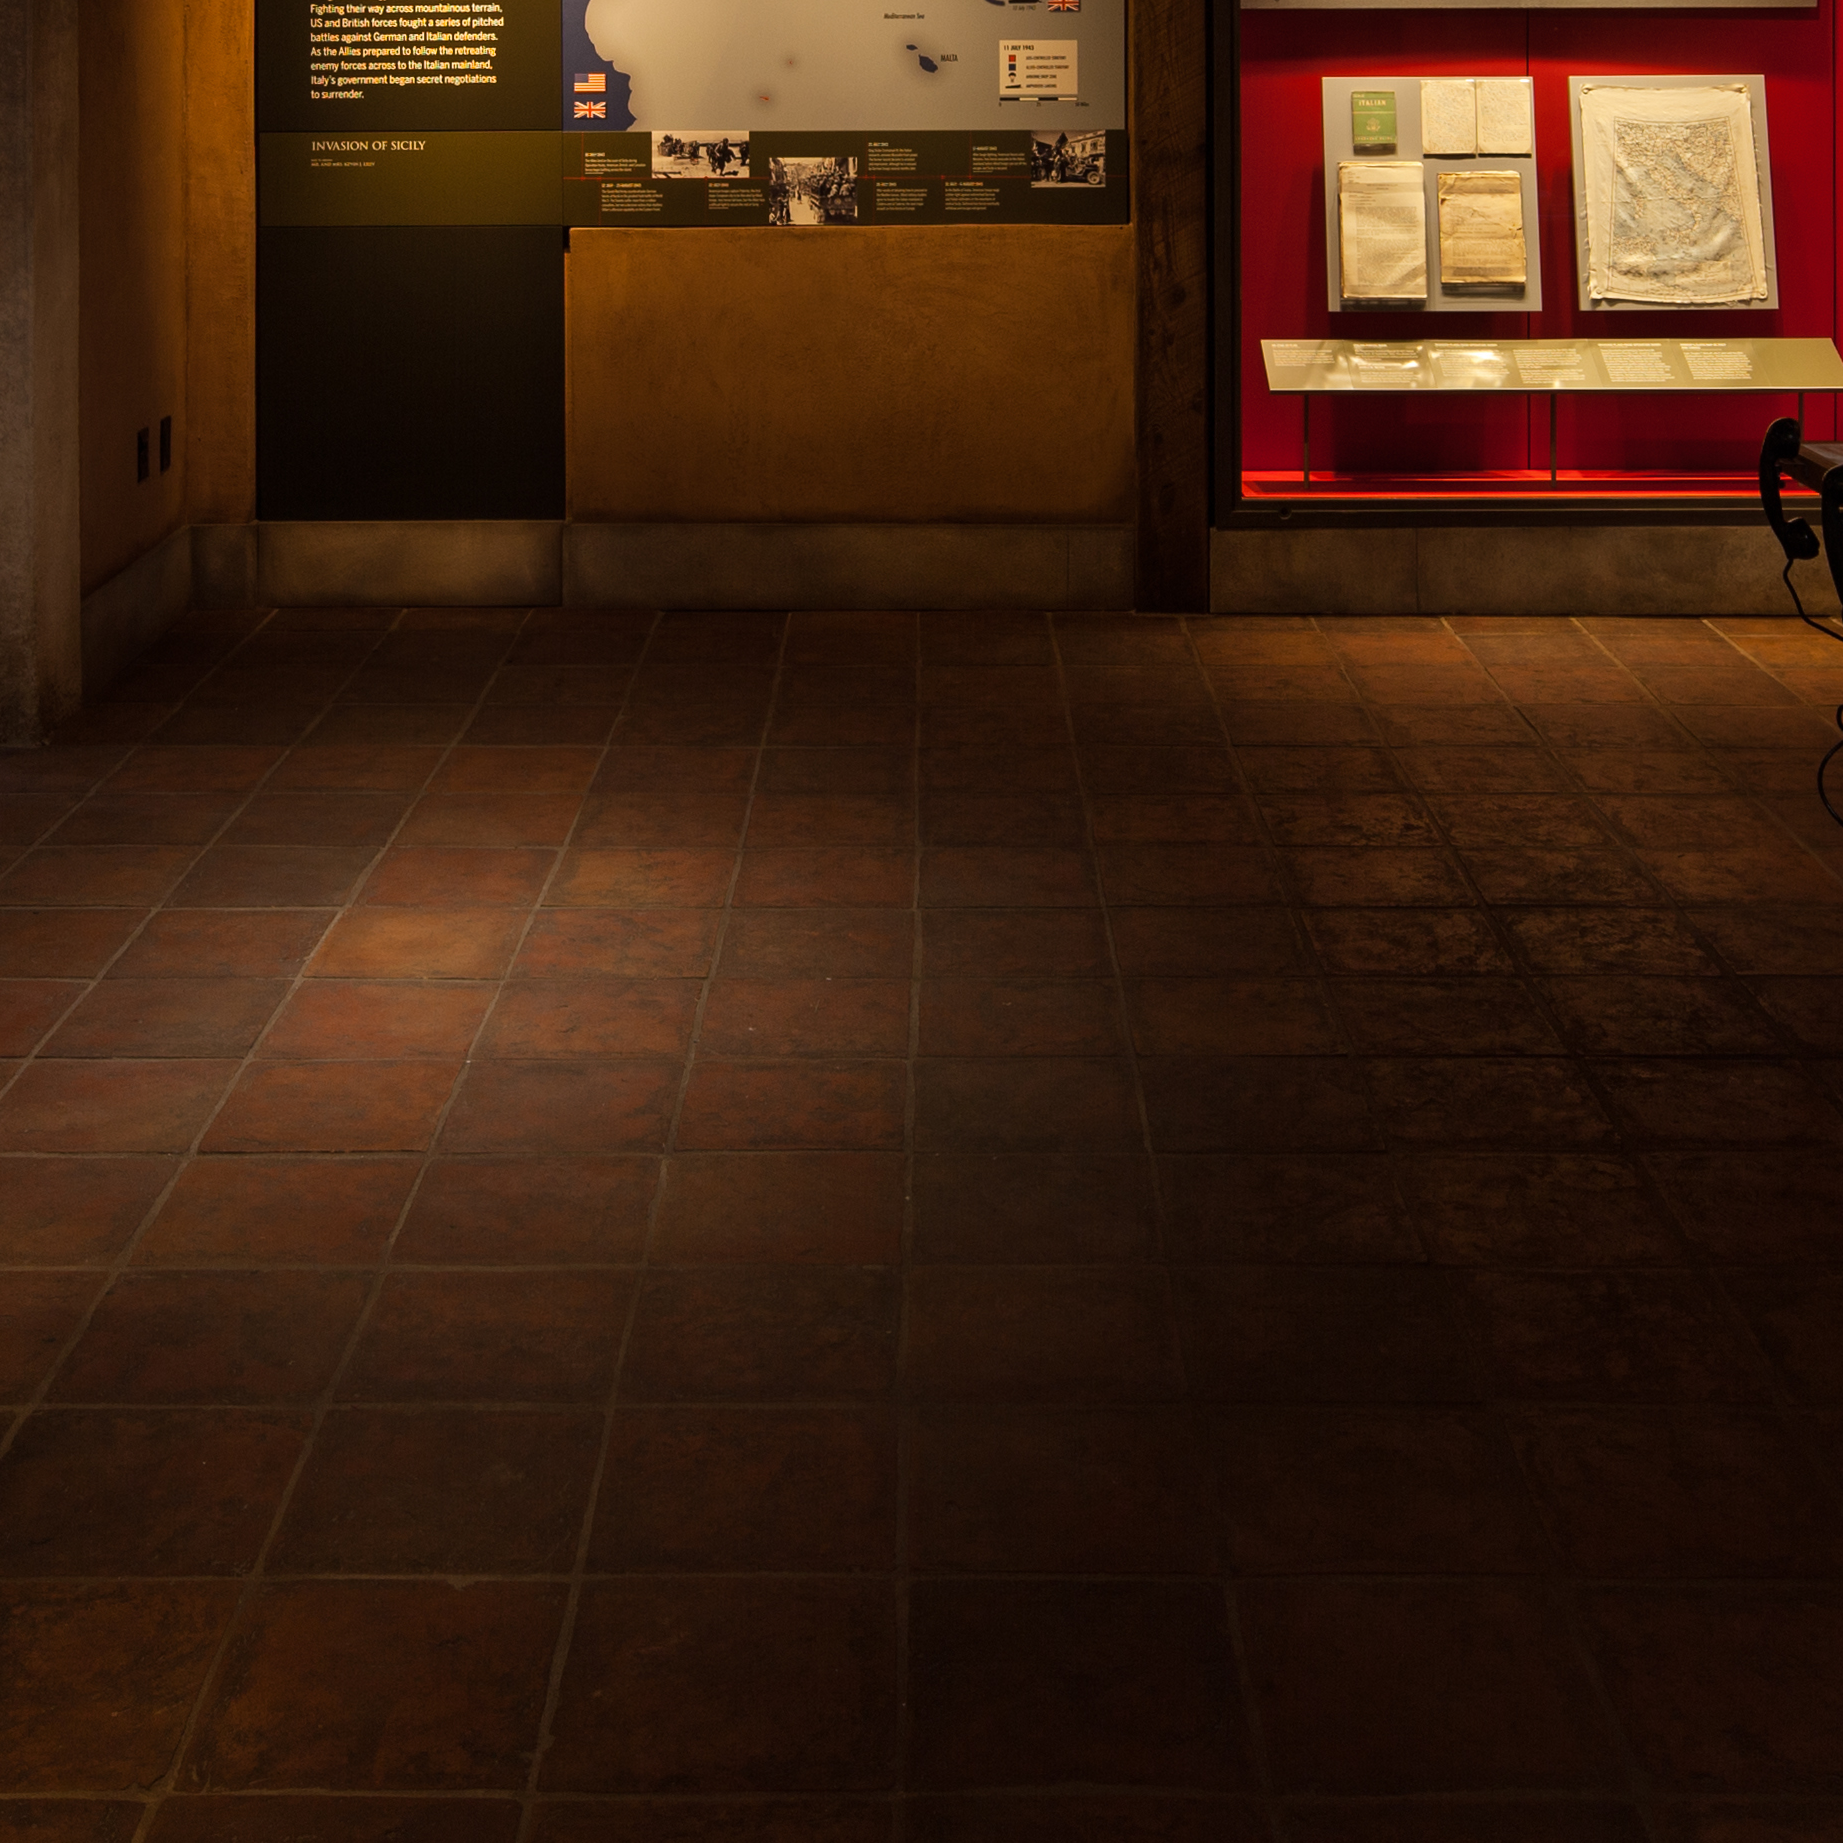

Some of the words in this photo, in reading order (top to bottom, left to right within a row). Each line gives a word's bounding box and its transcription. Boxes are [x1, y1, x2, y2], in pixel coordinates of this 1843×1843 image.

[310, 3, 344, 15] Fighting
[346, 3, 365, 13] their
[367, 6, 384, 15] way
[386, 5, 413, 13] across
[415, 2, 470, 12] mountainous
[472, 2, 502, 13] terrain,
[940, 54, 958, 62] MALTA
[312, 141, 368, 151] INVASION
[372, 141, 388, 150] OF
[391, 141, 426, 150] SICILY
